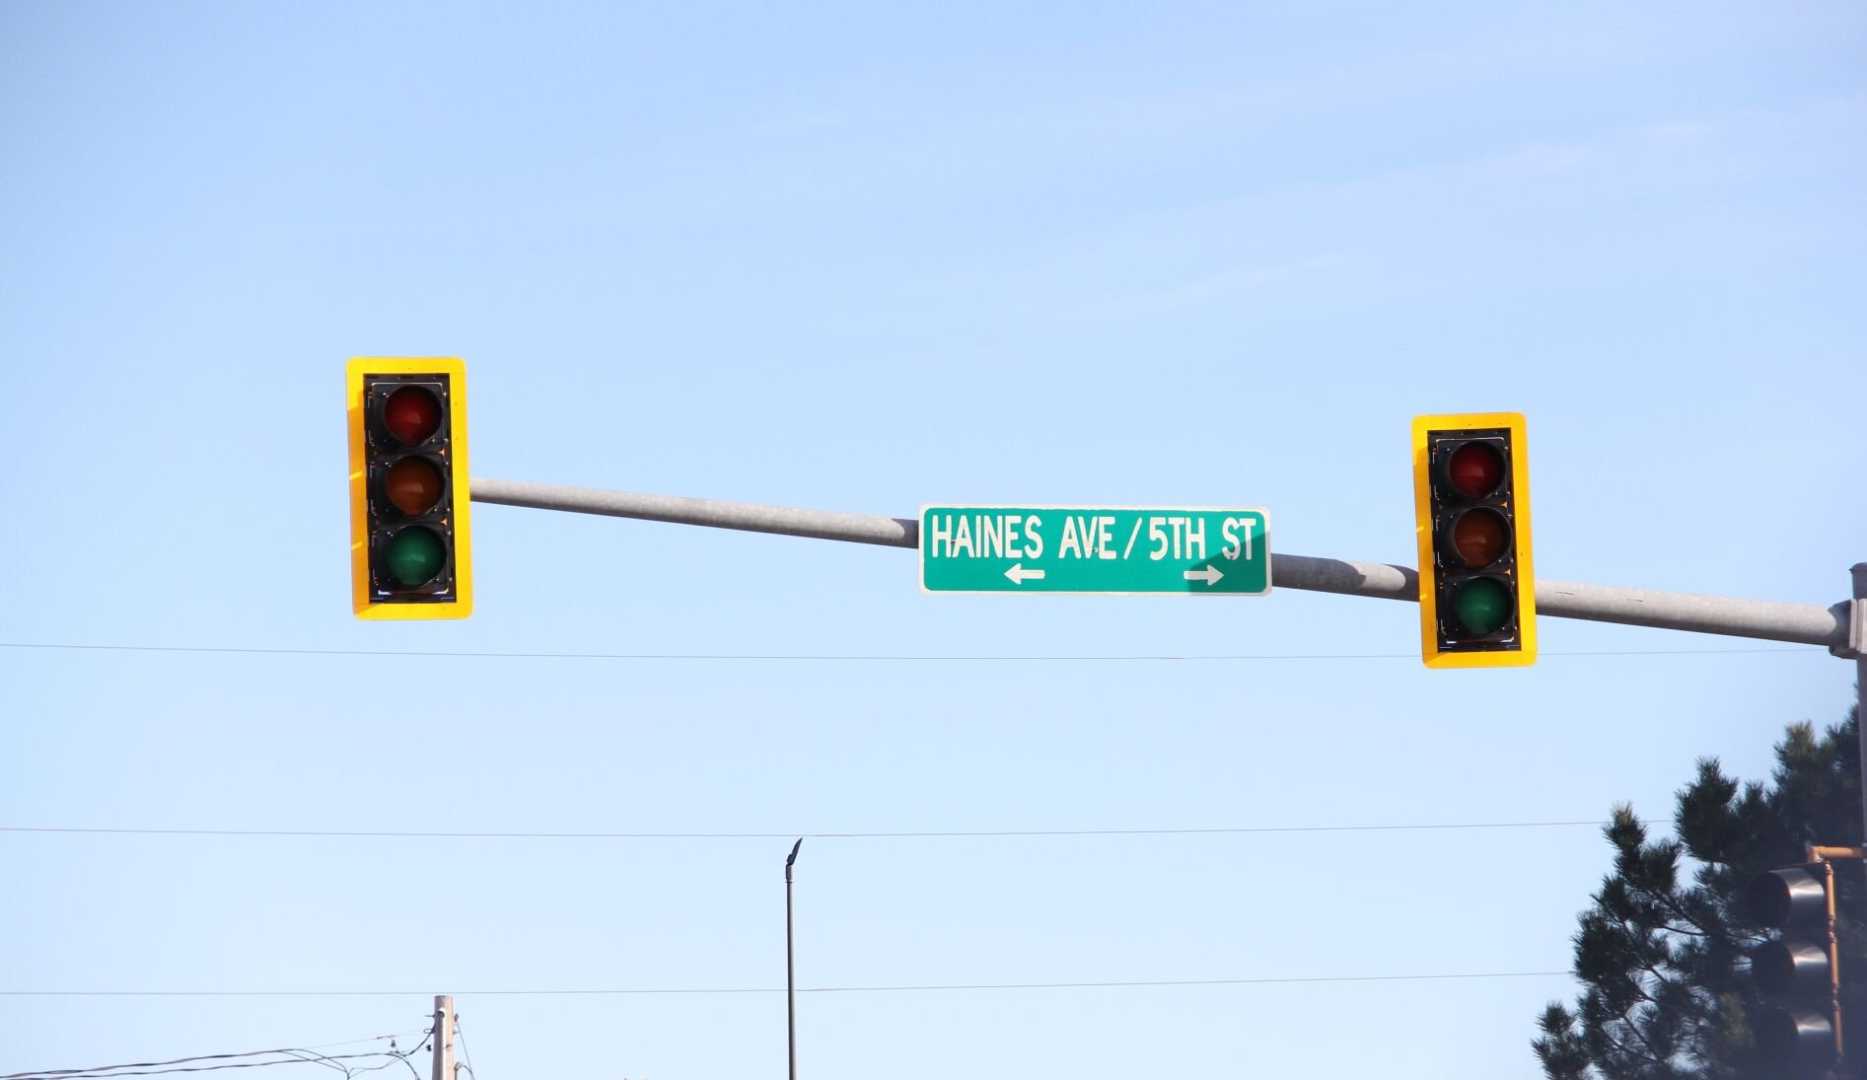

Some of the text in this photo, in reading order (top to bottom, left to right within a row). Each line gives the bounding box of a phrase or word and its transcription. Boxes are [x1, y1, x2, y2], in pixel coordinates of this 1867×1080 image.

[931, 514, 1044, 559] HAINES
[1058, 515, 1117, 560] AVE
[1148, 517, 1206, 561] 5TH
[1221, 516, 1257, 561] ST
